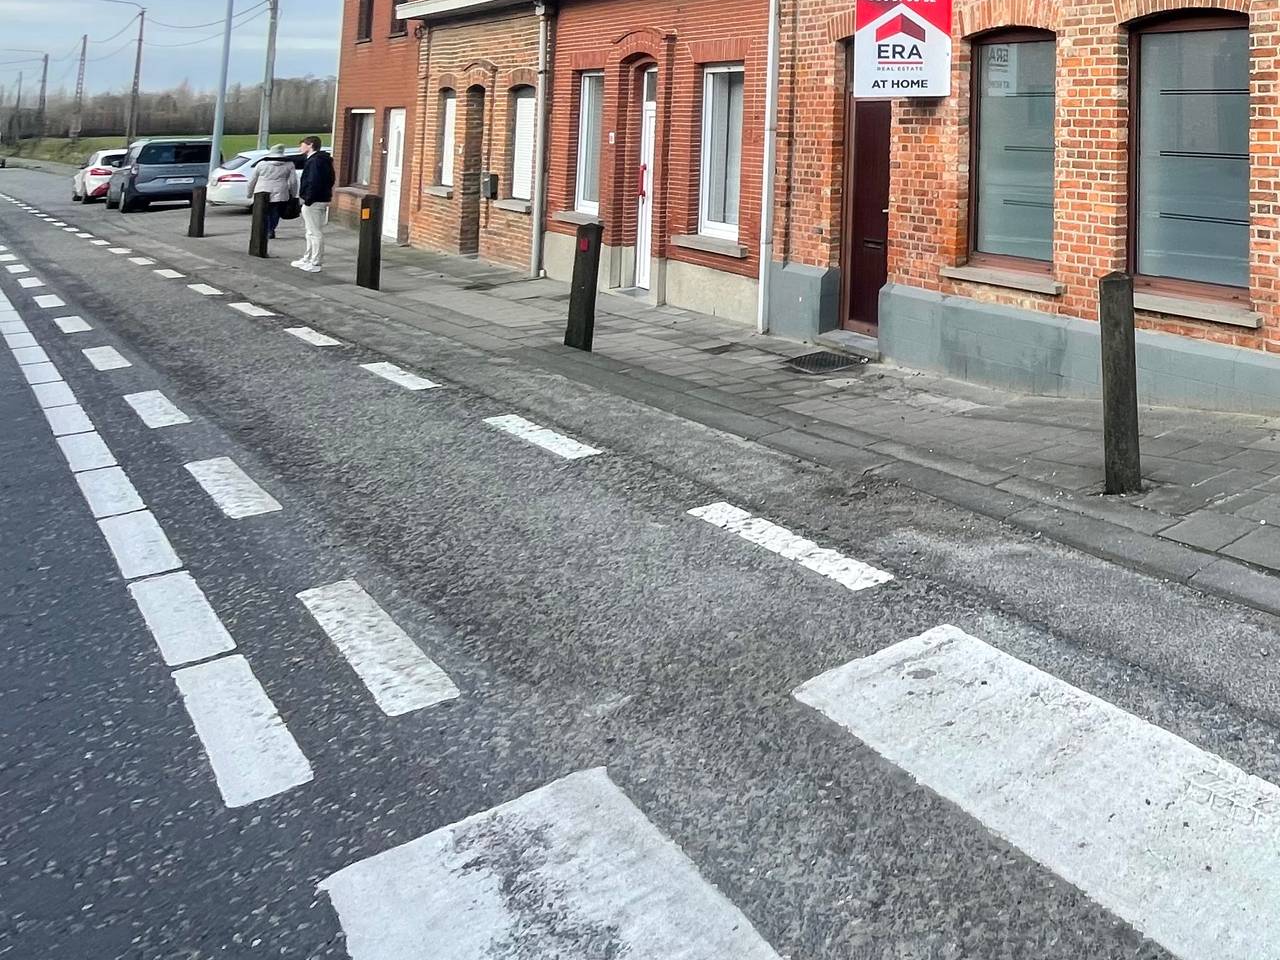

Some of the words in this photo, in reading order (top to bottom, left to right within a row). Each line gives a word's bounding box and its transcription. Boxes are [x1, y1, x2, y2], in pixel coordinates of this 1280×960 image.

[877, 44, 923, 59] ERA
[871, 79, 888, 89] AT
[891, 79, 929, 89] HOME
